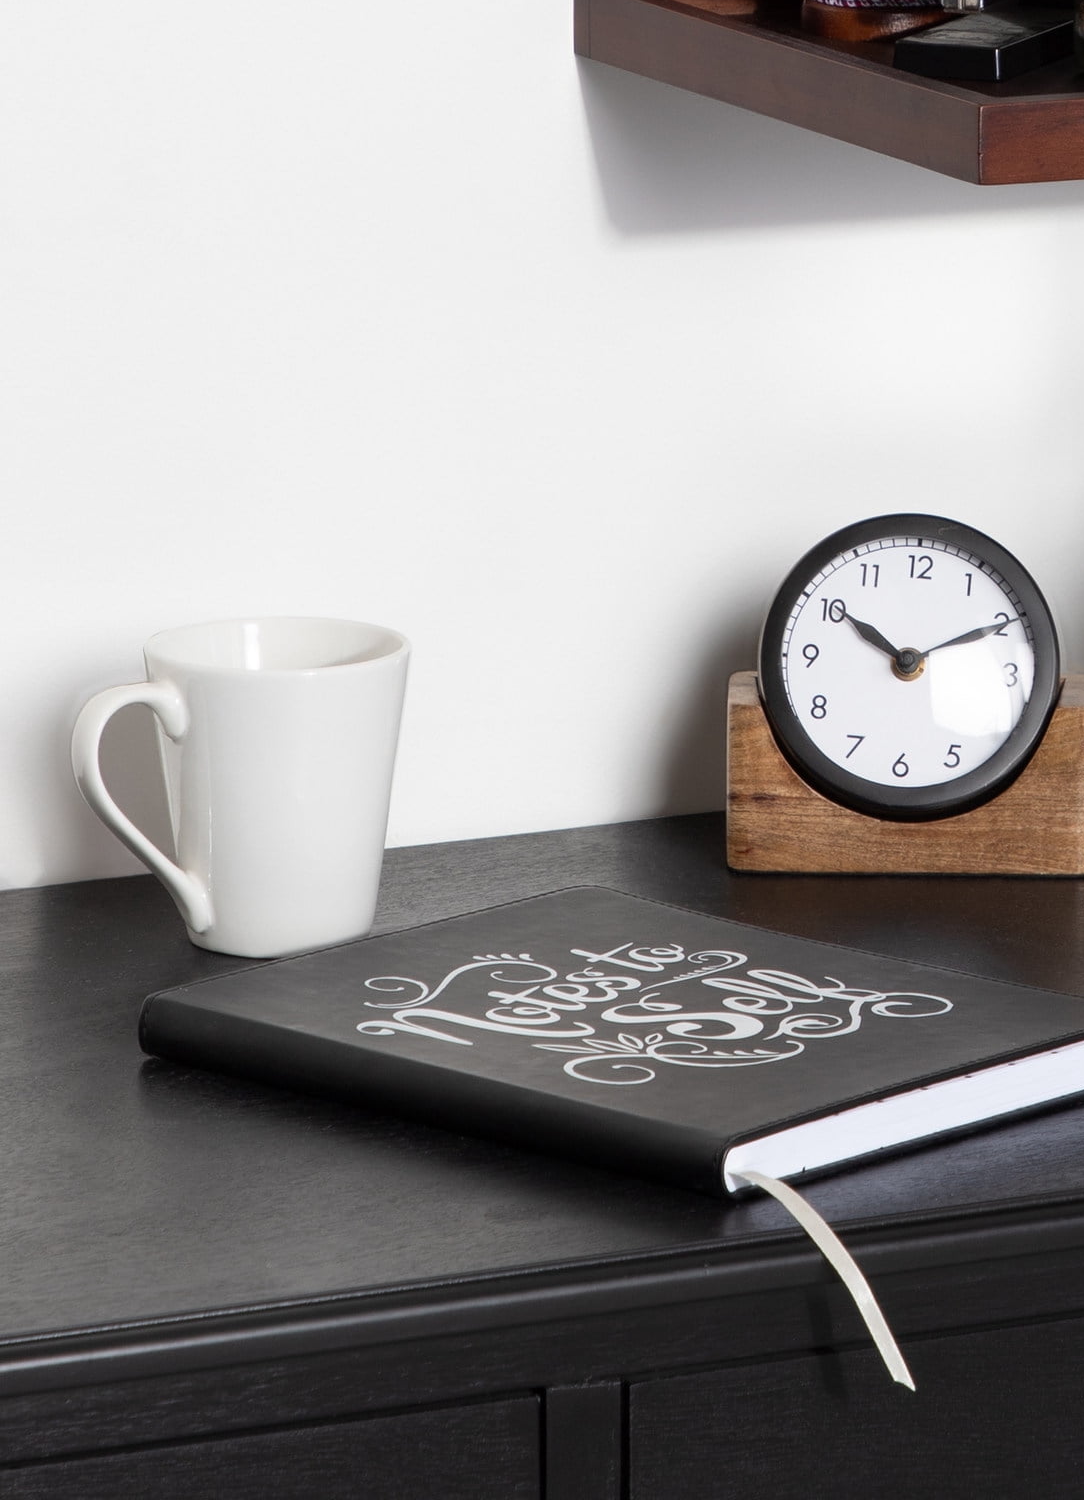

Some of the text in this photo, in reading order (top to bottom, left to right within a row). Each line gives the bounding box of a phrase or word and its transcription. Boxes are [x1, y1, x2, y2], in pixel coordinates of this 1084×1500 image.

[860, 564, 880, 588] 11
[908, 554, 934, 580] 12
[964, 573, 973, 597] 1
[820, 598, 847, 623] 10
[992, 612, 1010, 637] 2
[802, 643, 820, 668] 9
[1003, 663, 1018, 687] 3
[810, 695, 827, 720] 8
[846, 734, 866, 759] 7
[943, 744, 962, 769] 5
[891, 753, 909, 778] 6
[356, 942, 685, 1046] Notes to
[601, 970, 888, 1040] Self
